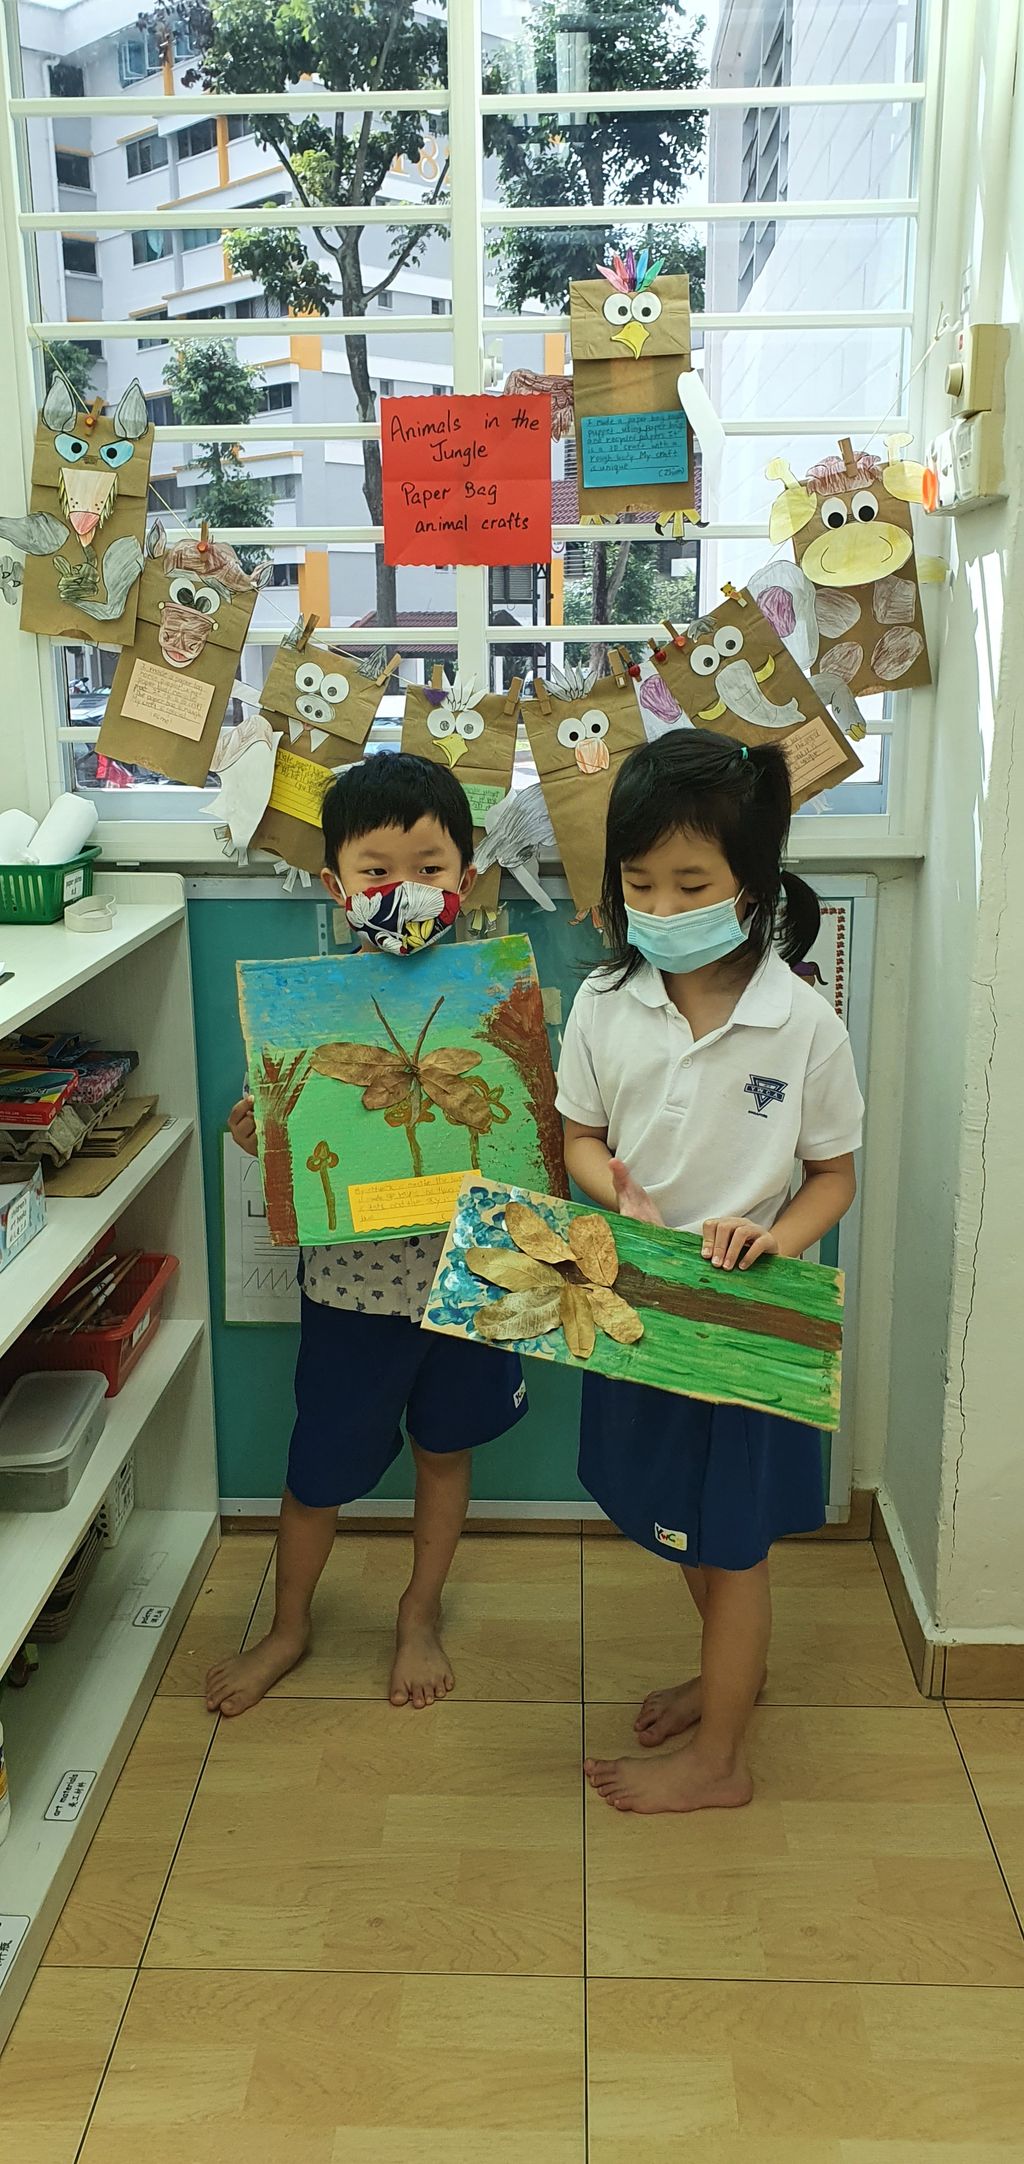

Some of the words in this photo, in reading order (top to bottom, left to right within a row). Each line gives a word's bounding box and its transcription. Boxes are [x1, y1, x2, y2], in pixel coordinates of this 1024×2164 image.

[391, 409, 461, 442] Animals
[484, 413, 500, 430] in
[512, 409, 540, 431] the
[430, 439, 488, 467] Jungle
[401, 481, 451, 508] Paper
[464, 481, 498, 505] Bag
[415, 514, 468, 533] animal
[481, 512, 529, 530] crafts
